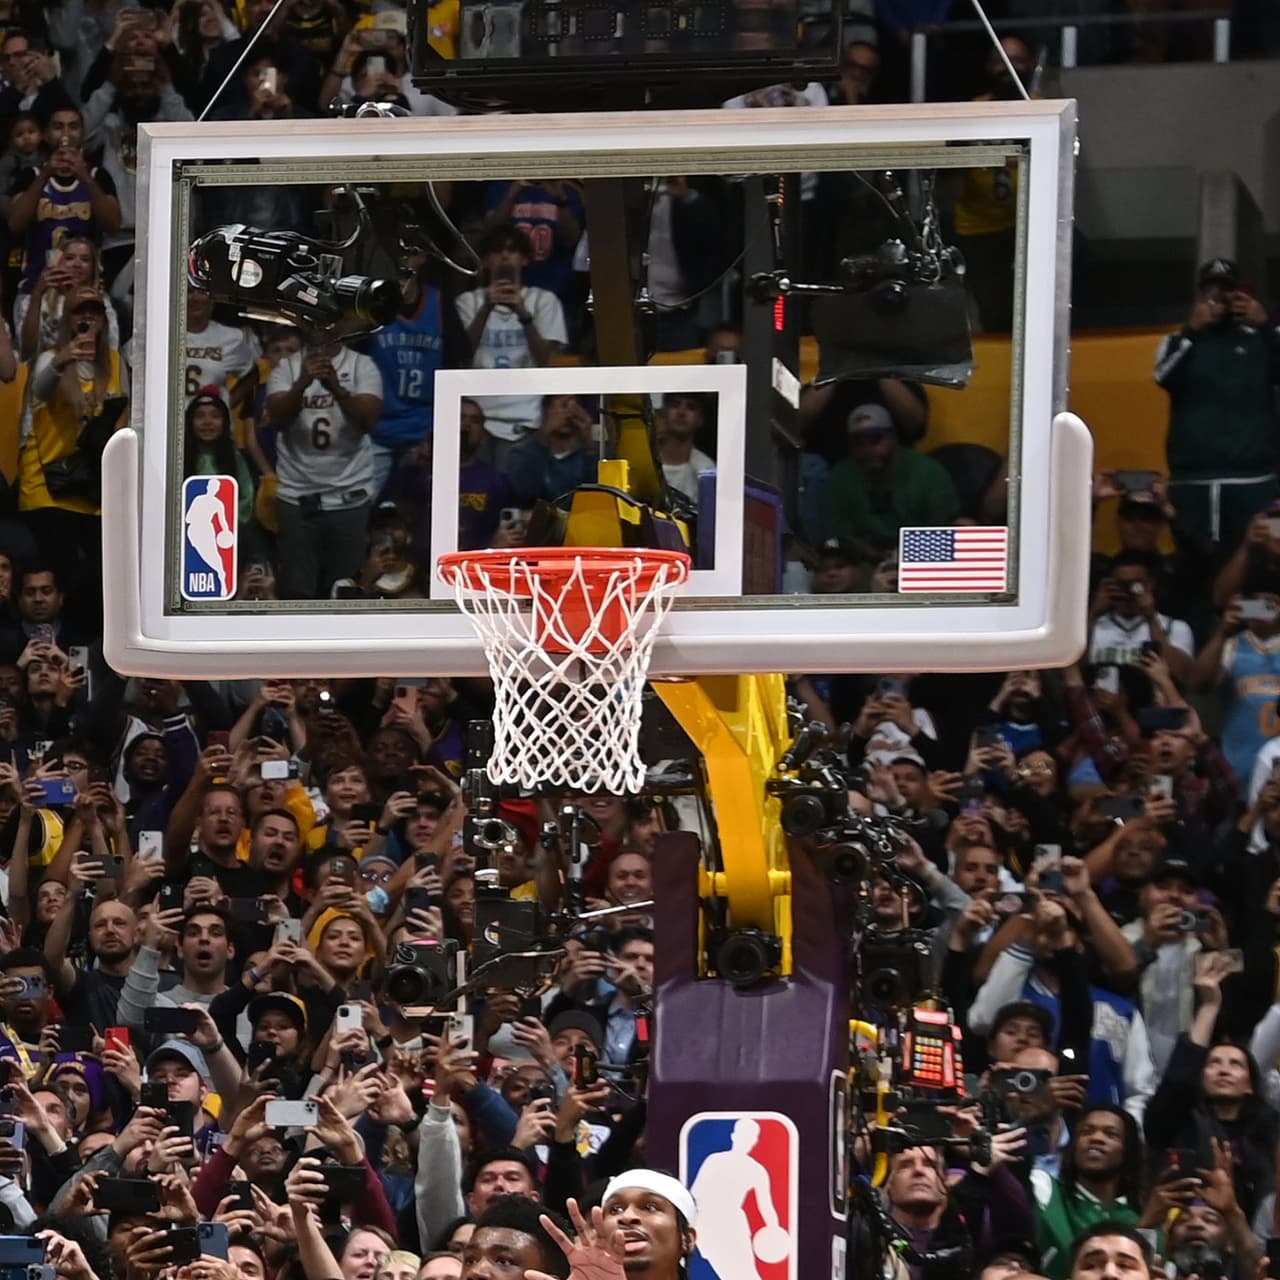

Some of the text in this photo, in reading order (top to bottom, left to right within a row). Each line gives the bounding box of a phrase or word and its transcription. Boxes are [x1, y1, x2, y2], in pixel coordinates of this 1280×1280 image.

[185, 347, 223, 362] KERS
[185, 364, 202, 396] 6
[397, 368, 423, 397] 12
[313, 418, 331, 451] 6
[189, 572, 216, 594] NBA
